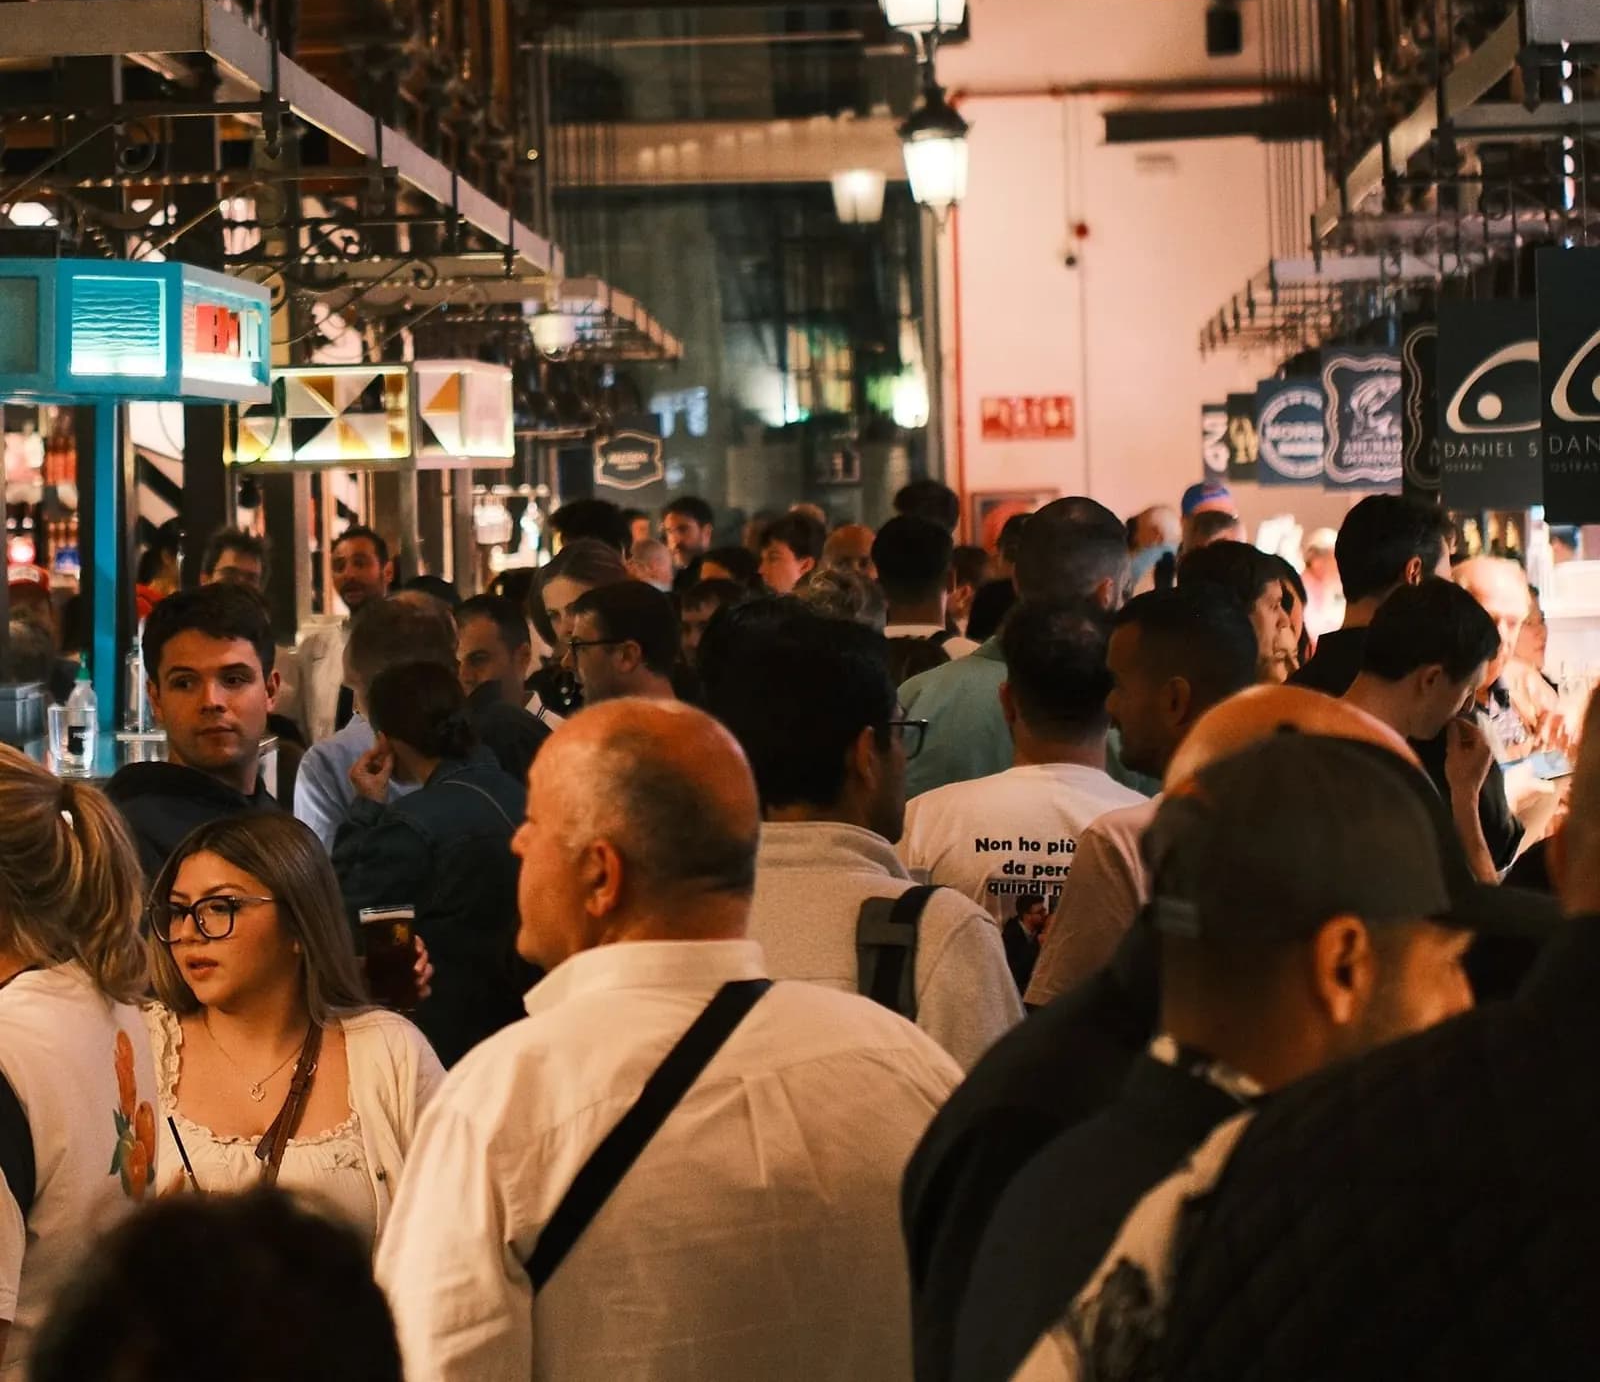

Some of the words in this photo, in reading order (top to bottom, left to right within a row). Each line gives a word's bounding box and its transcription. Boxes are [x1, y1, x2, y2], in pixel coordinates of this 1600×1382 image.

[1444, 442, 1514, 458] DANIEL
[1528, 442, 1538, 458] S
[1549, 434, 1600, 455] DAN
[975, 837, 1012, 853] Non
[1019, 836, 1041, 852] ho
[1047, 839, 1076, 855] più
[1002, 860, 1026, 875] da
[987, 880, 1046, 897] quindi
